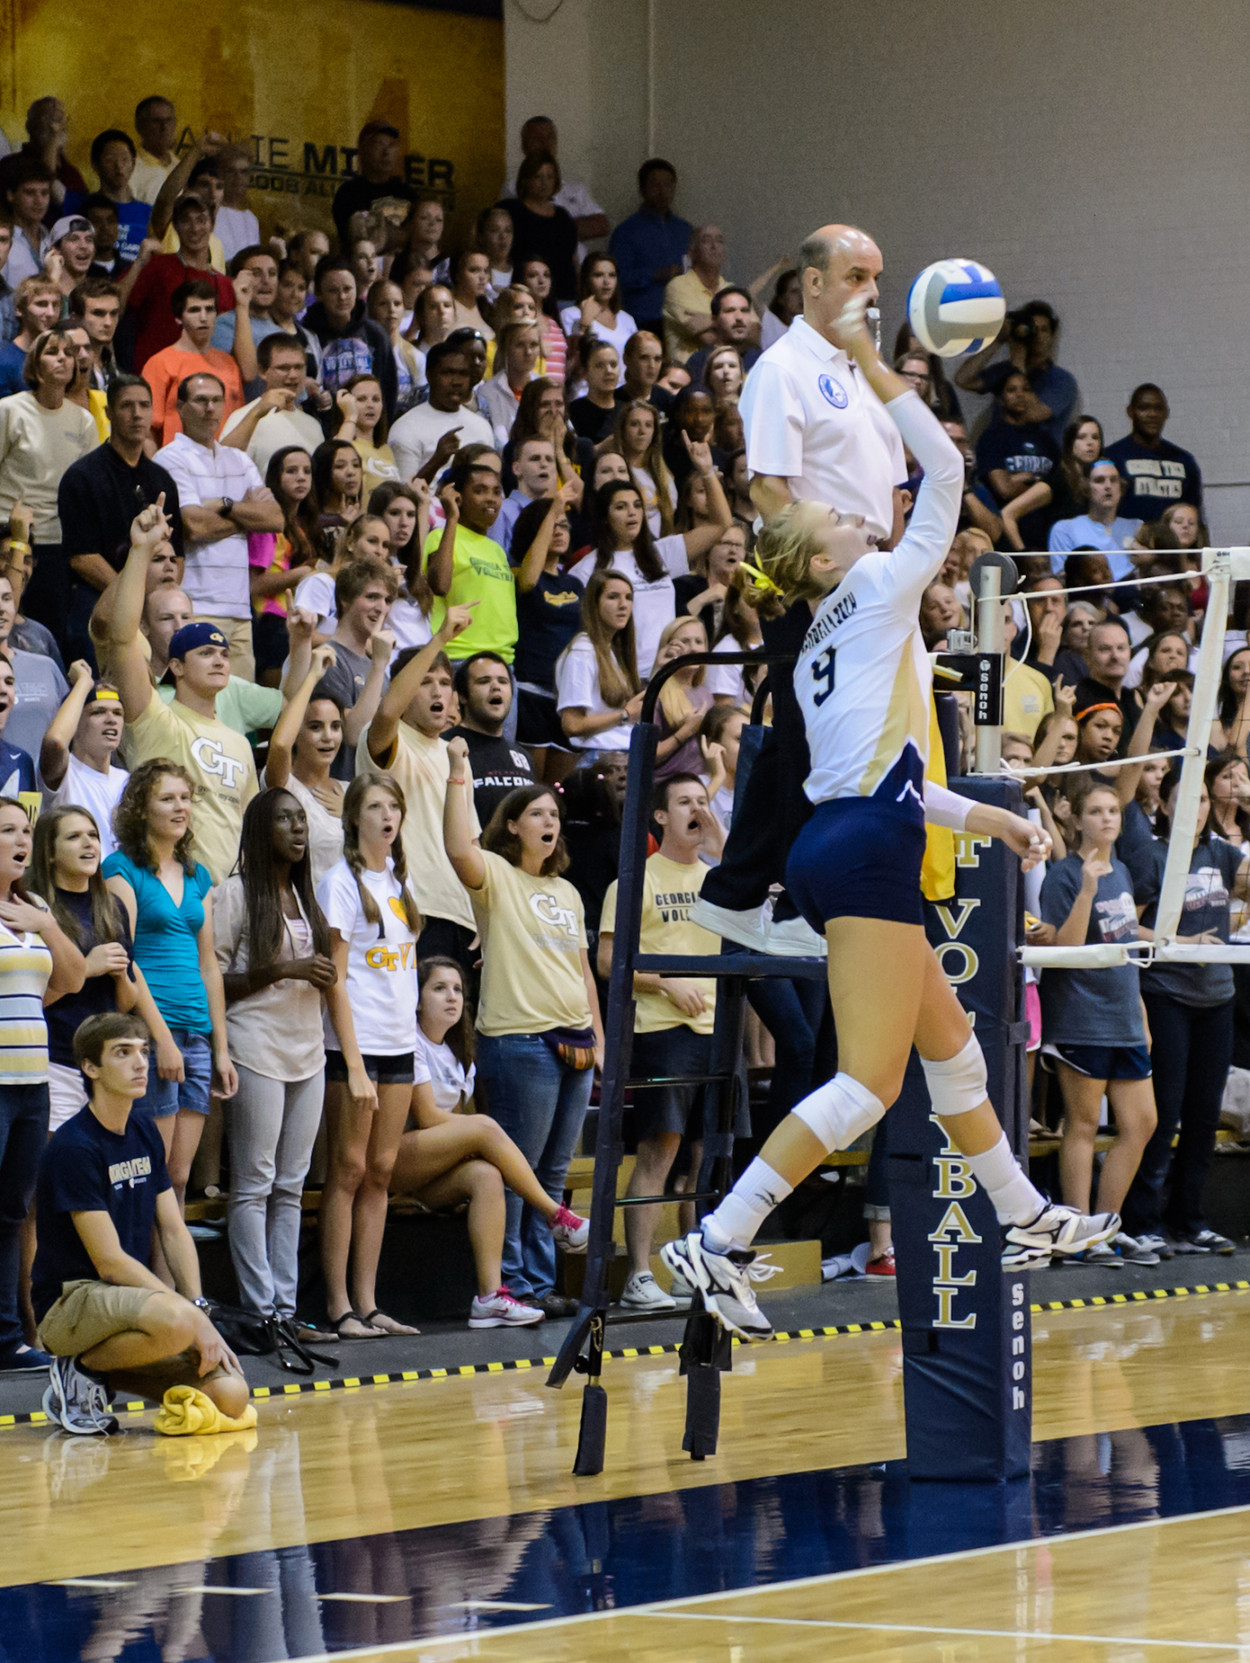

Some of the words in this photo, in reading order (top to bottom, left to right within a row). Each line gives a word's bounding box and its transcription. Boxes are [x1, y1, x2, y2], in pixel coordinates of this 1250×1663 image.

[176, 126, 290, 170] AIE
[303, 142, 455, 190] MIER
[811, 644, 836, 708] 9
[190, 736, 244, 789] GT
[528, 892, 580, 937] GT
[655, 891, 702, 906] GEORGI
[366, 946, 400, 971] GT
[930, 898, 982, 1330] VOYBALL
[1011, 1283, 1025, 1411] senoh
